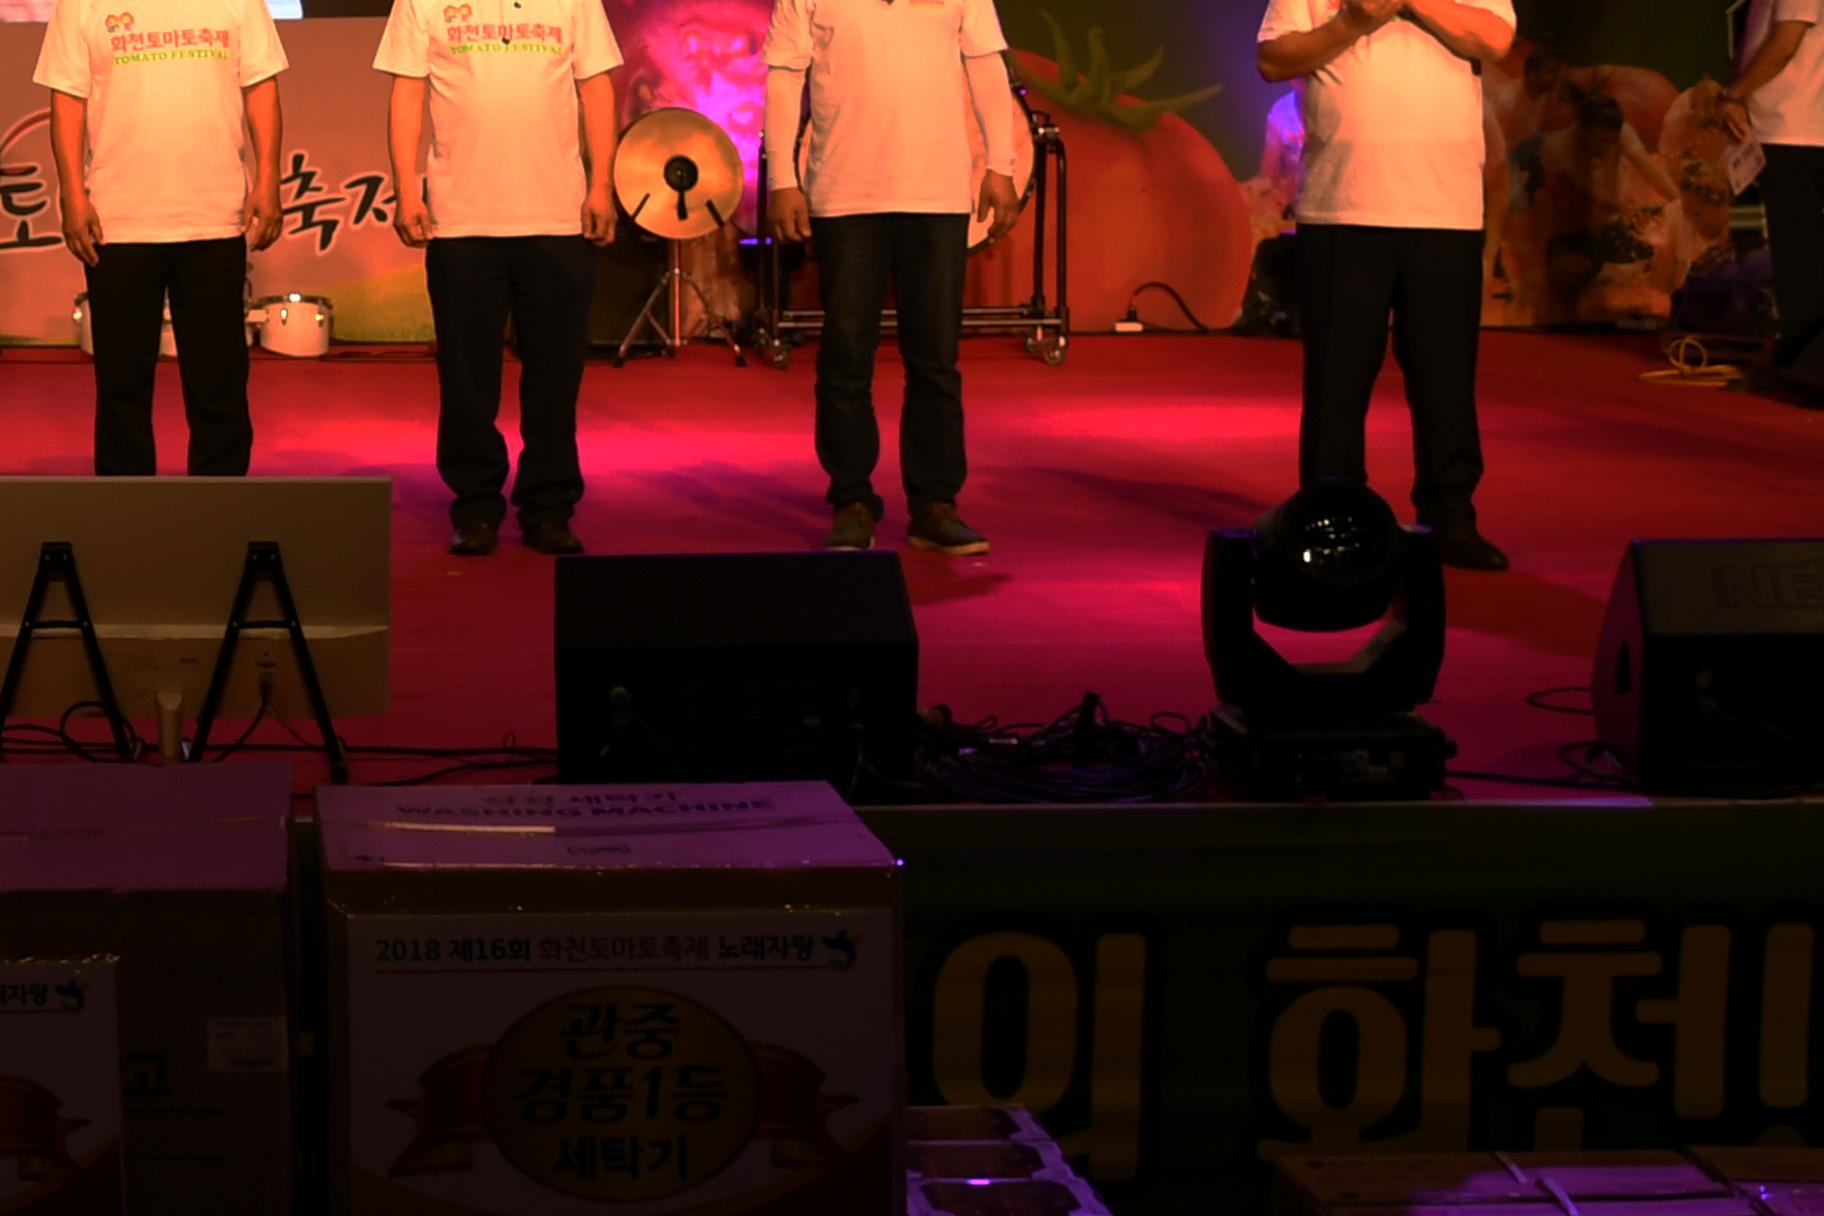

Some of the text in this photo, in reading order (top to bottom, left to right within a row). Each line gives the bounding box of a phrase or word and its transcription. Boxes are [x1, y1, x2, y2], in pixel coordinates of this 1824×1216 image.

[111, 27, 229, 52] 화천토마토축제
[448, 23, 562, 43] 화천토마토축제
[114, 48, 229, 65] TOMATO FESTIVAL
[451, 42, 562, 54] TOMATO FESTIVAL
[397, 798, 773, 818] WASHING MACHINE
[376, 933, 813, 963] 2018 제16회 화천토마토축제 노래자랑
[562, 1004, 682, 1062] 관중
[518, 1065, 729, 1125] 경품1등
[554, 1138, 689, 1180] 세탁기
